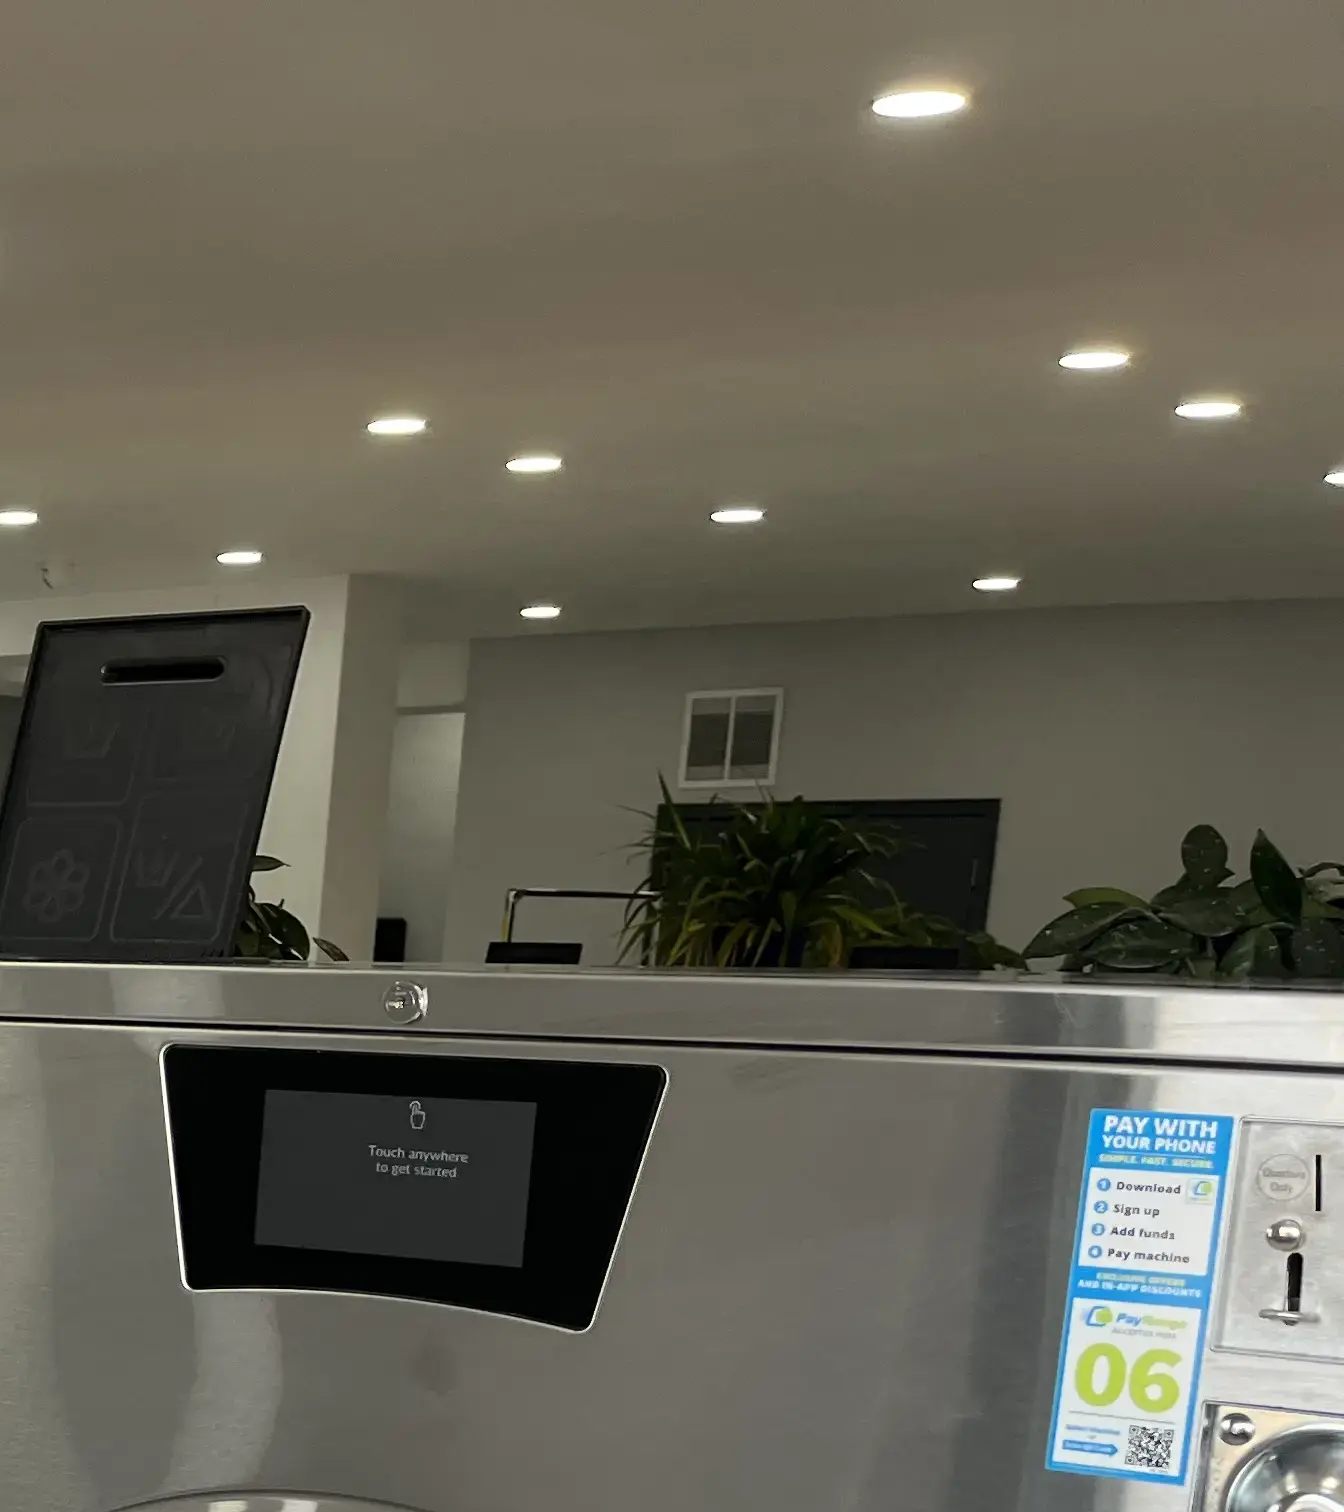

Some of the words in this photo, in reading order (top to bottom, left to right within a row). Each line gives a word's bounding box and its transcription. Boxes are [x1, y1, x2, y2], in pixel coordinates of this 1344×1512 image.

[1103, 1115, 1151, 1135] PAY
[1154, 1118, 1218, 1138] WITH
[1102, 1135, 1150, 1150] YOUR
[1155, 1139, 1216, 1154] PHONE
[368, 1144, 405, 1159] Touch
[408, 1149, 469, 1163] anywhere
[375, 1161, 389, 1173] to
[391, 1164, 410, 1176] get
[413, 1165, 458, 1178] started
[1116, 1182, 1181, 1194] Download
[1113, 1204, 1140, 1216] Sign
[1144, 1207, 1160, 1218] up
[1110, 1226, 1135, 1237] Add
[1139, 1228, 1175, 1240] funds
[1107, 1248, 1130, 1261] Pay
[1134, 1250, 1190, 1264] machine
[1075, 1342, 1182, 1414] 06
